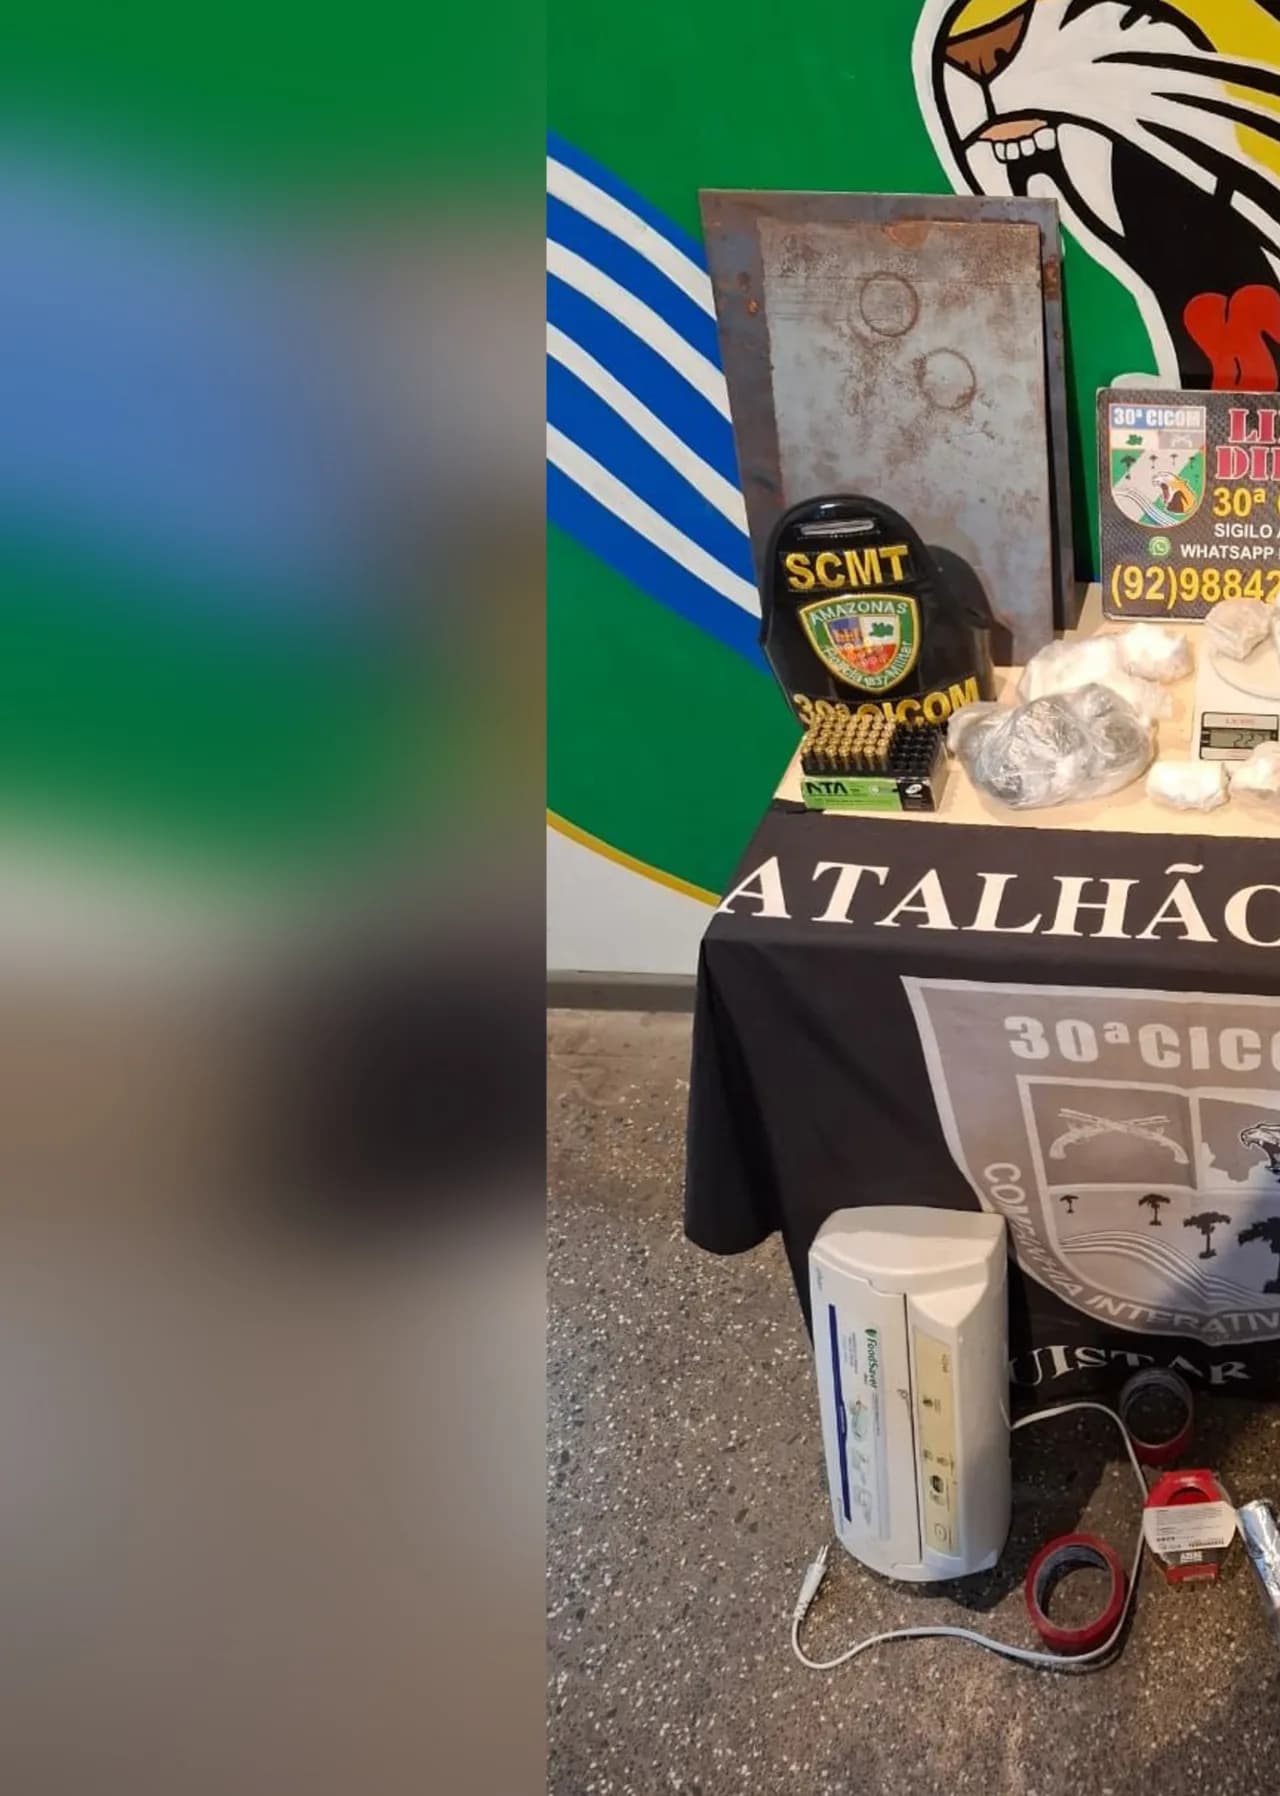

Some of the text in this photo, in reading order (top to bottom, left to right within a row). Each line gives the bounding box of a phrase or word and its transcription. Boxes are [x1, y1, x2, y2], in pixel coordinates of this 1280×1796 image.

[1214, 524, 1273, 540] SIGILO
[1180, 544, 1274, 560] WHATSAPP
[785, 544, 908, 590] SCMT
[809, 600, 908, 625] AMAZONAS
